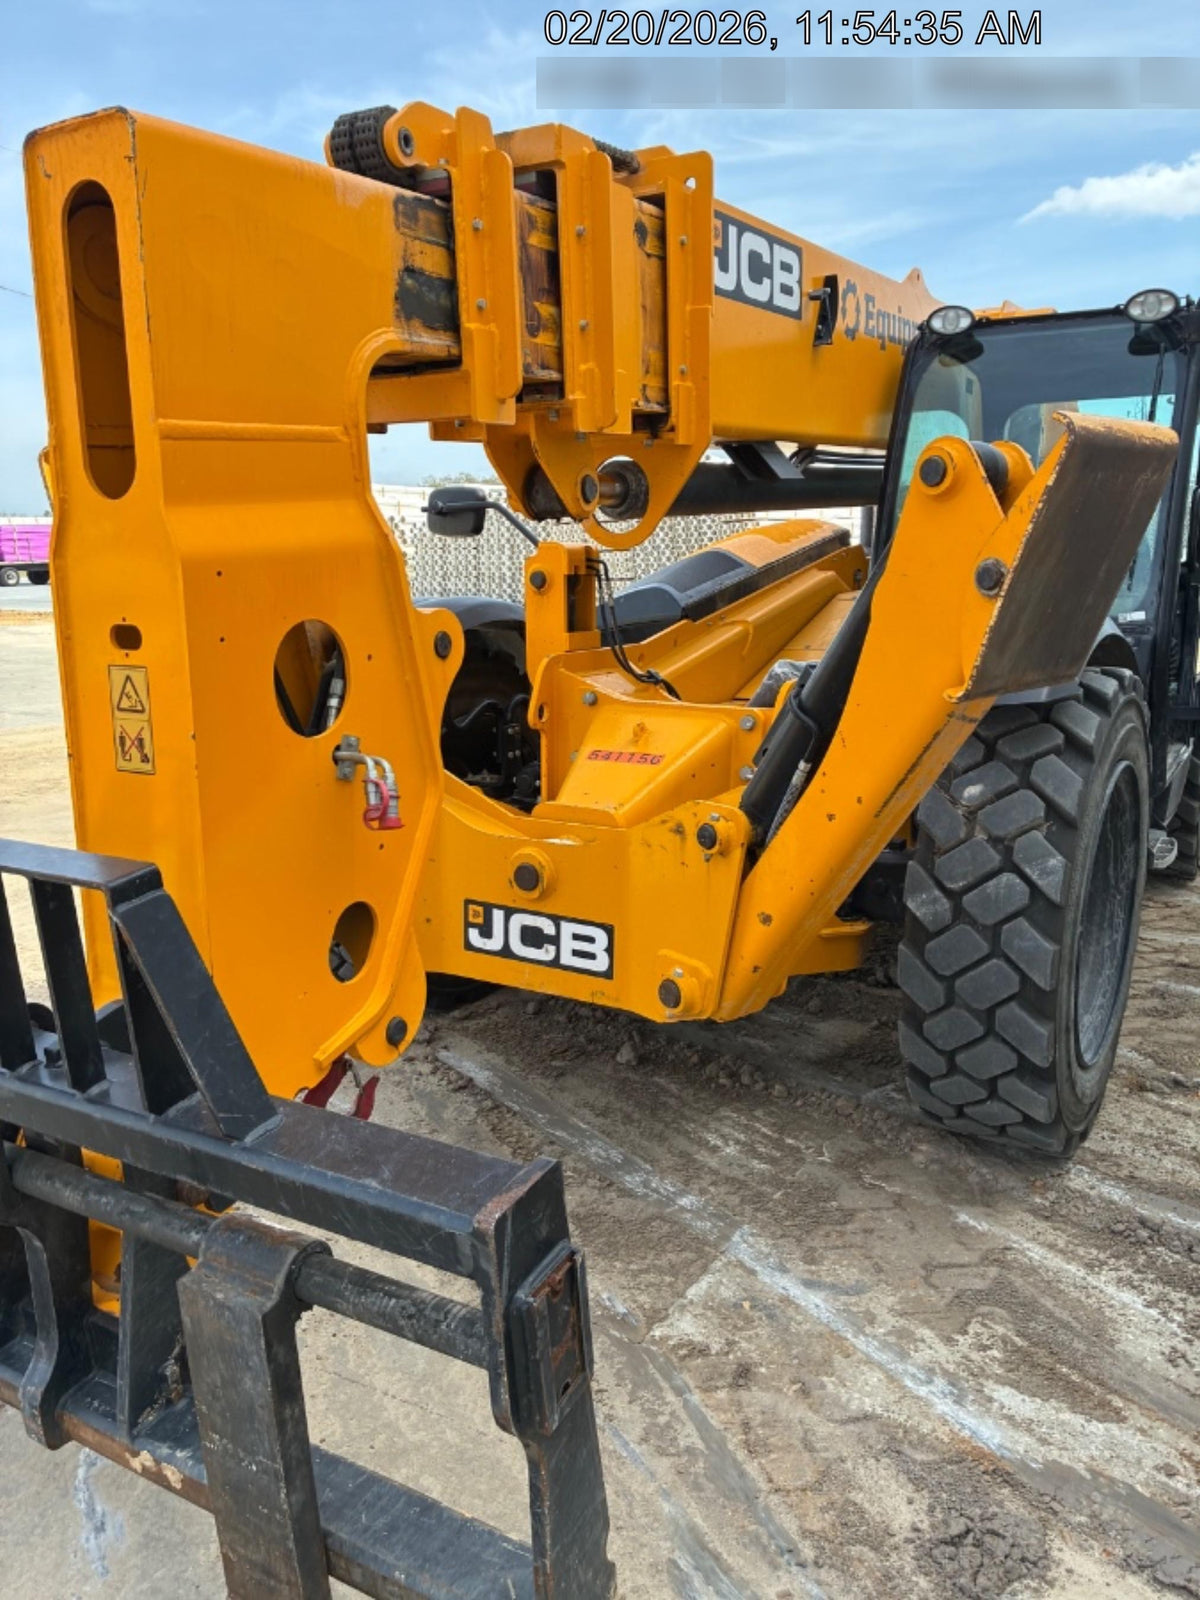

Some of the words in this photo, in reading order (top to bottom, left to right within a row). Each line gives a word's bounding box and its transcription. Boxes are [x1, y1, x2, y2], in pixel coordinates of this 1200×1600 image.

[714, 223, 801, 312] JCB
[864, 292, 919, 356] Equip
[468, 908, 610, 972] JCB
